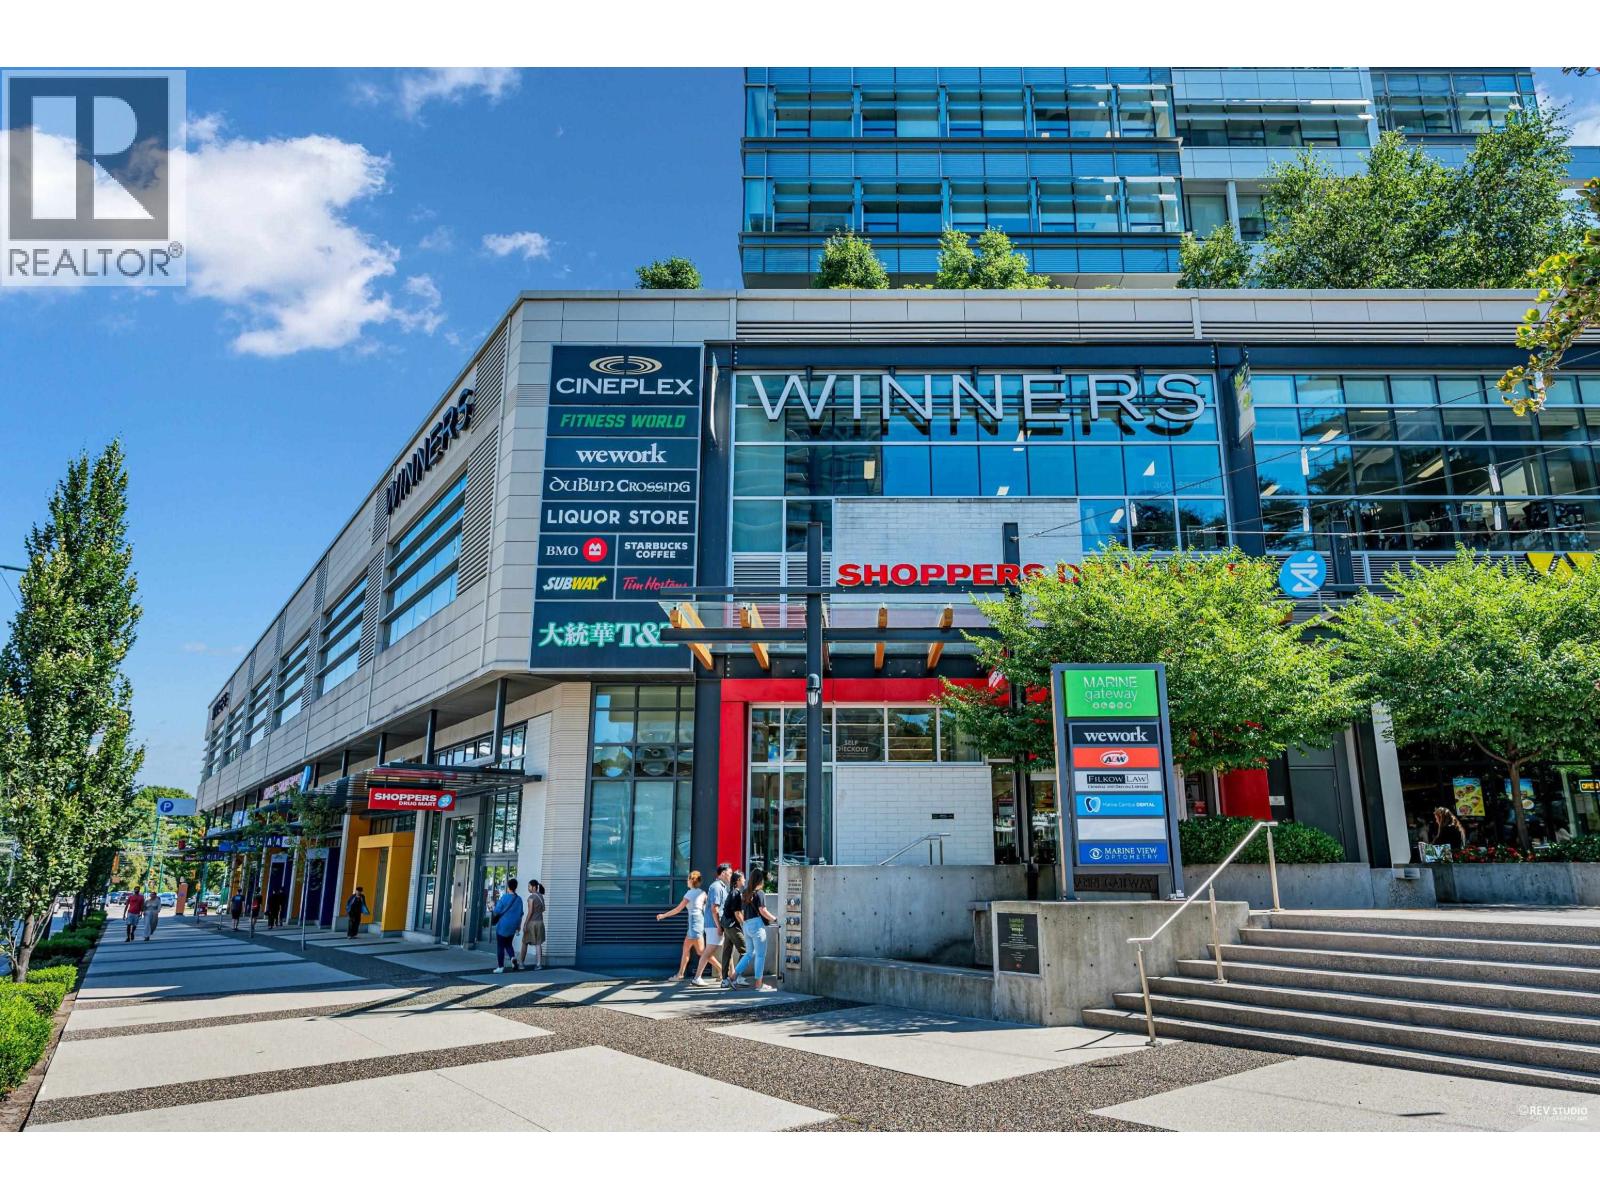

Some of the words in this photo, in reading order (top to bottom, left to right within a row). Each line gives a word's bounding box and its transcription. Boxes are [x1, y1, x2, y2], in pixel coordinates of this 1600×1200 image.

[555, 377, 694, 396] CINEPLEX
[751, 371, 1206, 423] WINNERS
[560, 413, 626, 428] FITNESS
[631, 413, 687, 429] WORLD
[386, 387, 476, 516] WINNERS
[576, 442, 668, 464] wework
[547, 509, 621, 525] LIQUOR
[628, 510, 690, 525] STORE
[545, 545, 579, 556] BMO
[624, 541, 689, 551] STARBUCKS
[635, 550, 676, 559] COFFEE
[542, 575, 608, 591] SUBWAY
[623, 576, 644, 591] Tim
[538, 621, 615, 648] 大統華
[1083, 675, 1138, 688] MARINE
[1085, 688, 1138, 702] gateway
[1083, 726, 1148, 742] wework
[1088, 775, 1123, 783] FILKOW
[1126, 775, 1147, 783] LAW
[374, 792, 438, 802] SHOPPERS
[1104, 847, 1135, 855] MARINE
[1136, 847, 1158, 855] VIEW
